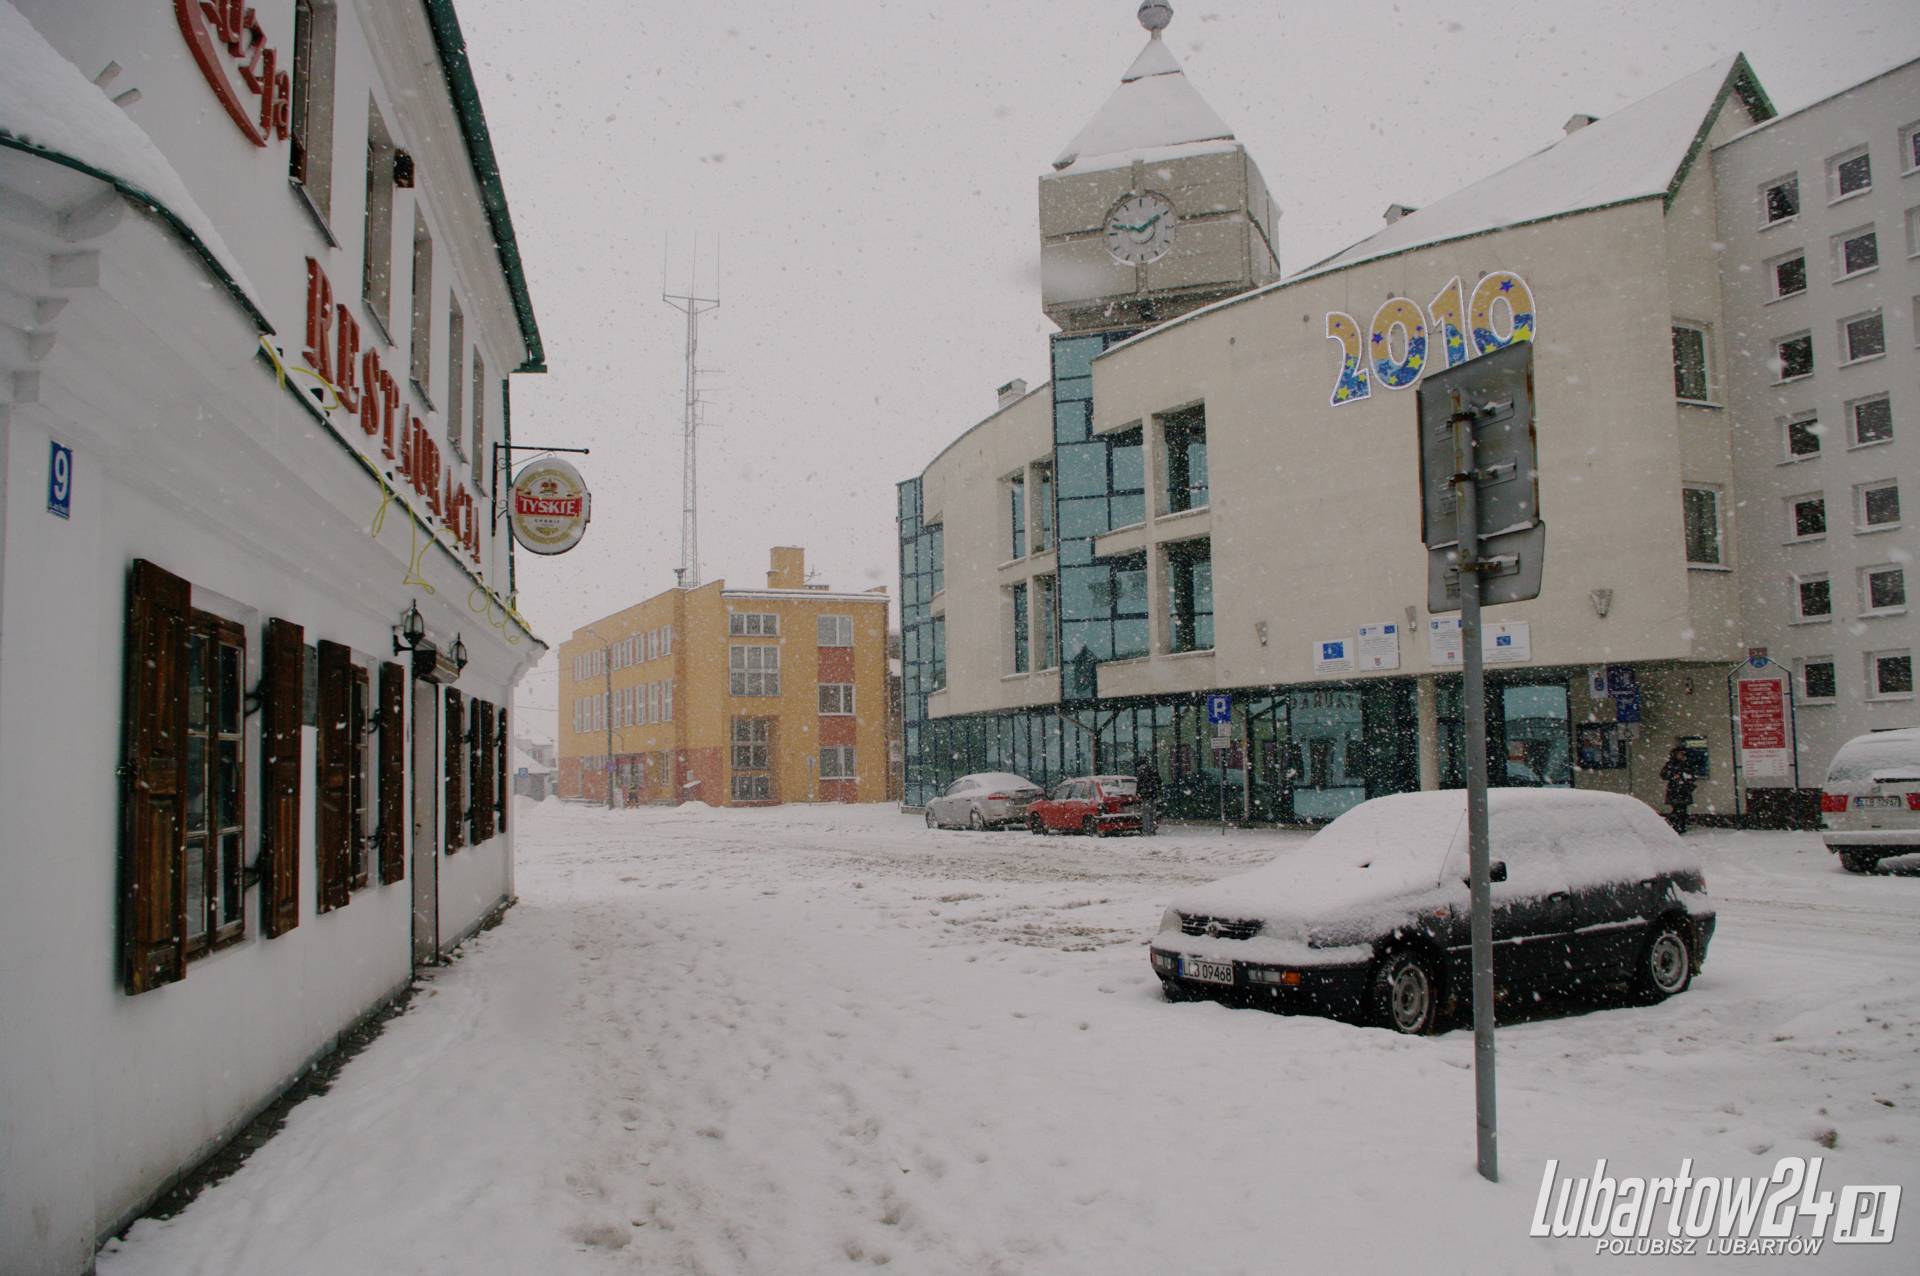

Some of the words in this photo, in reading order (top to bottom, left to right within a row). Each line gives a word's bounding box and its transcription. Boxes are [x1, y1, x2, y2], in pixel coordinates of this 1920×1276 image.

[1326, 271, 1536, 406] 2010
[302, 256, 481, 564] RESTAURACJA
[54, 449, 69, 501] 9
[520, 497, 576, 515] TYSKIE
[1213, 698, 1226, 718] P
[1202, 964, 1232, 982] 09468
